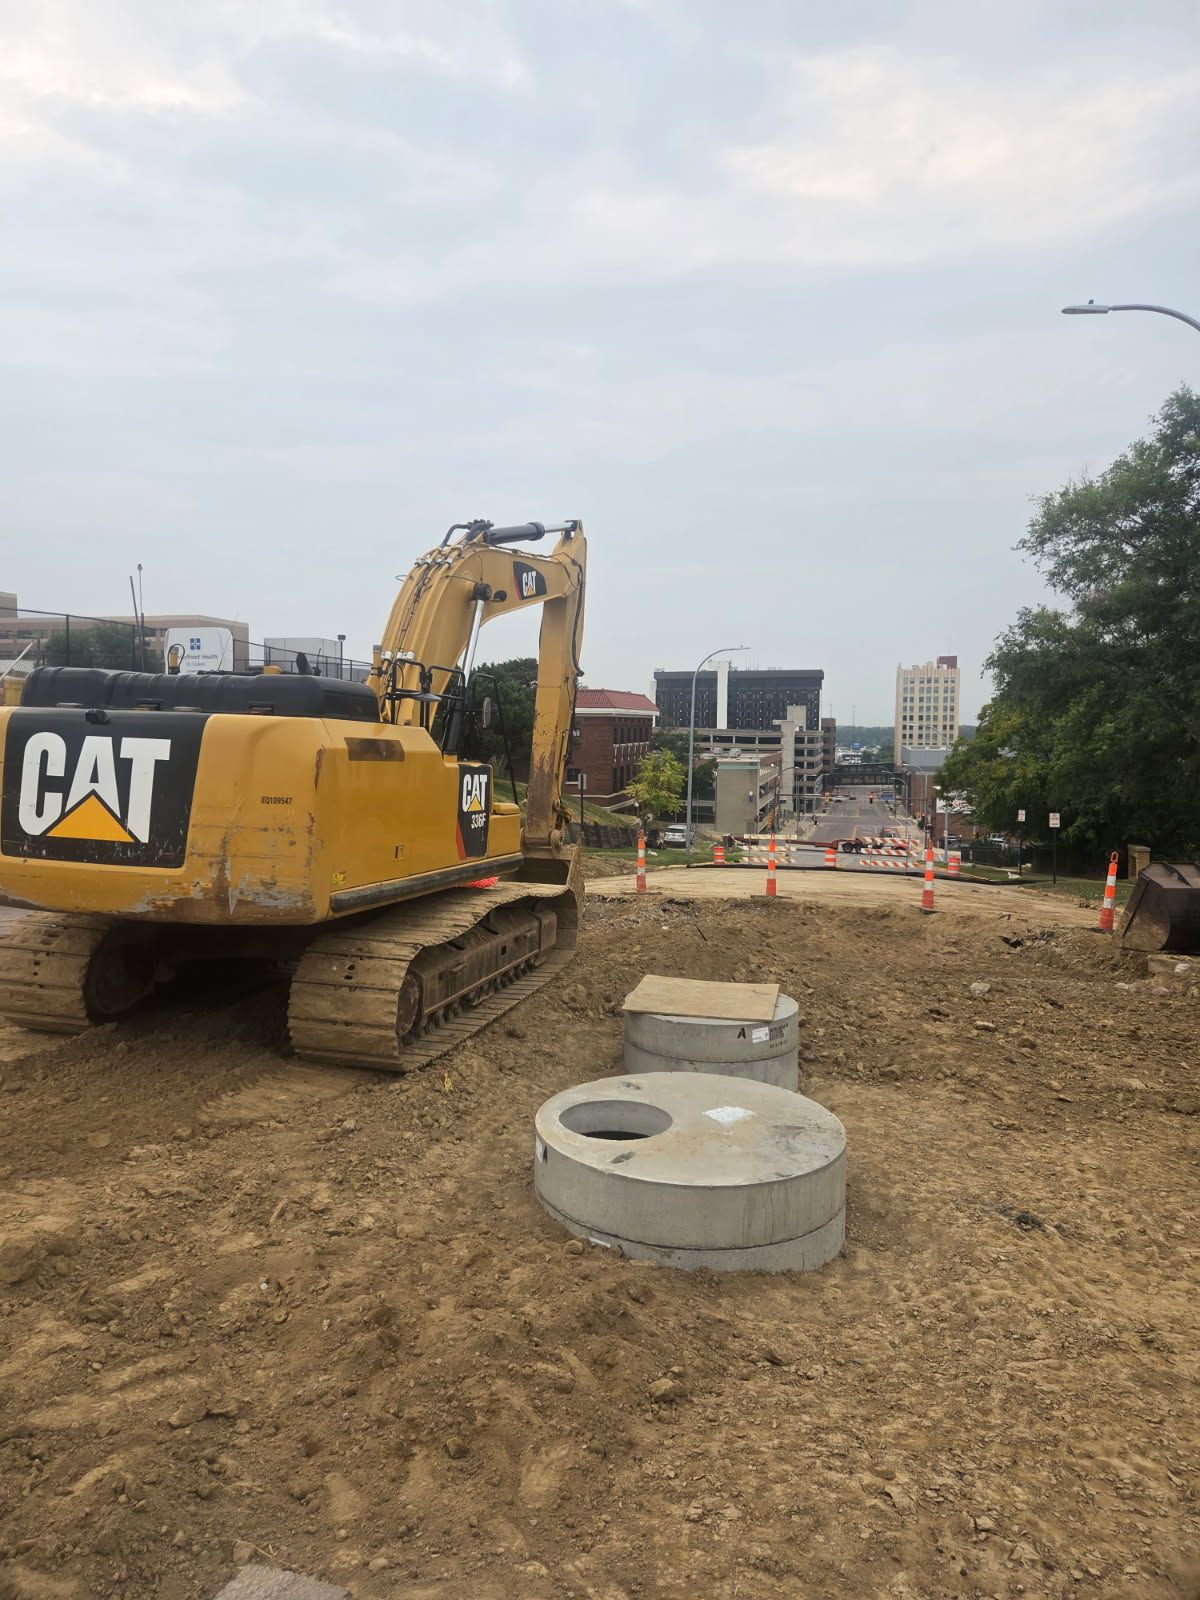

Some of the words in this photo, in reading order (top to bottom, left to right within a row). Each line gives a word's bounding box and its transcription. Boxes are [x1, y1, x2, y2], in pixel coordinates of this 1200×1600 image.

[522, 571, 537, 597] CAT
[18, 732, 171, 843] CAT
[462, 774, 488, 813] CAT
[261, 796, 293, 805] EQ109547
[471, 813, 486, 829] 336F
[737, 1027, 746, 1039] A
